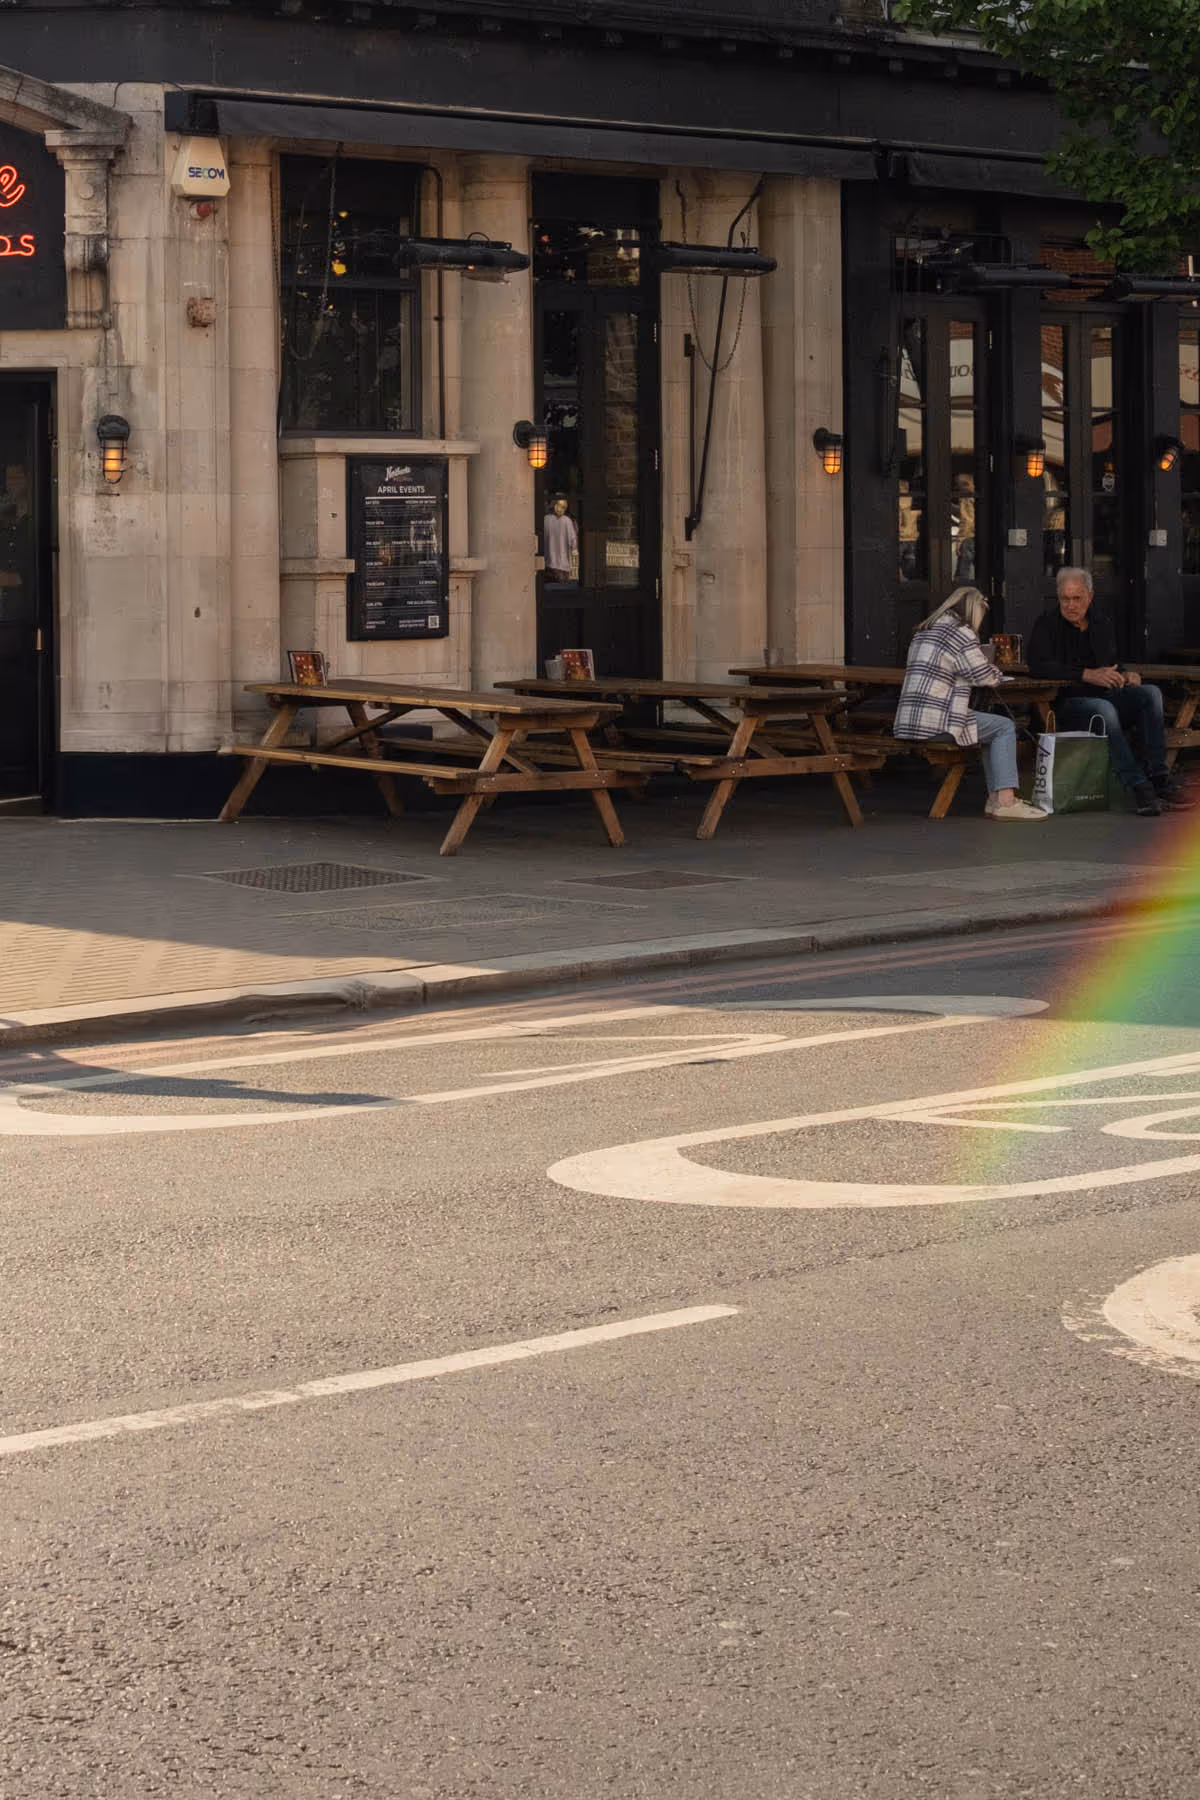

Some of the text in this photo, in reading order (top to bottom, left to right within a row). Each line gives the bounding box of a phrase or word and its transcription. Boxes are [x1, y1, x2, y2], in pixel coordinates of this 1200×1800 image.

[188, 167, 225, 179] SECOM
[377, 485, 425, 494] APRIL EVENTS
